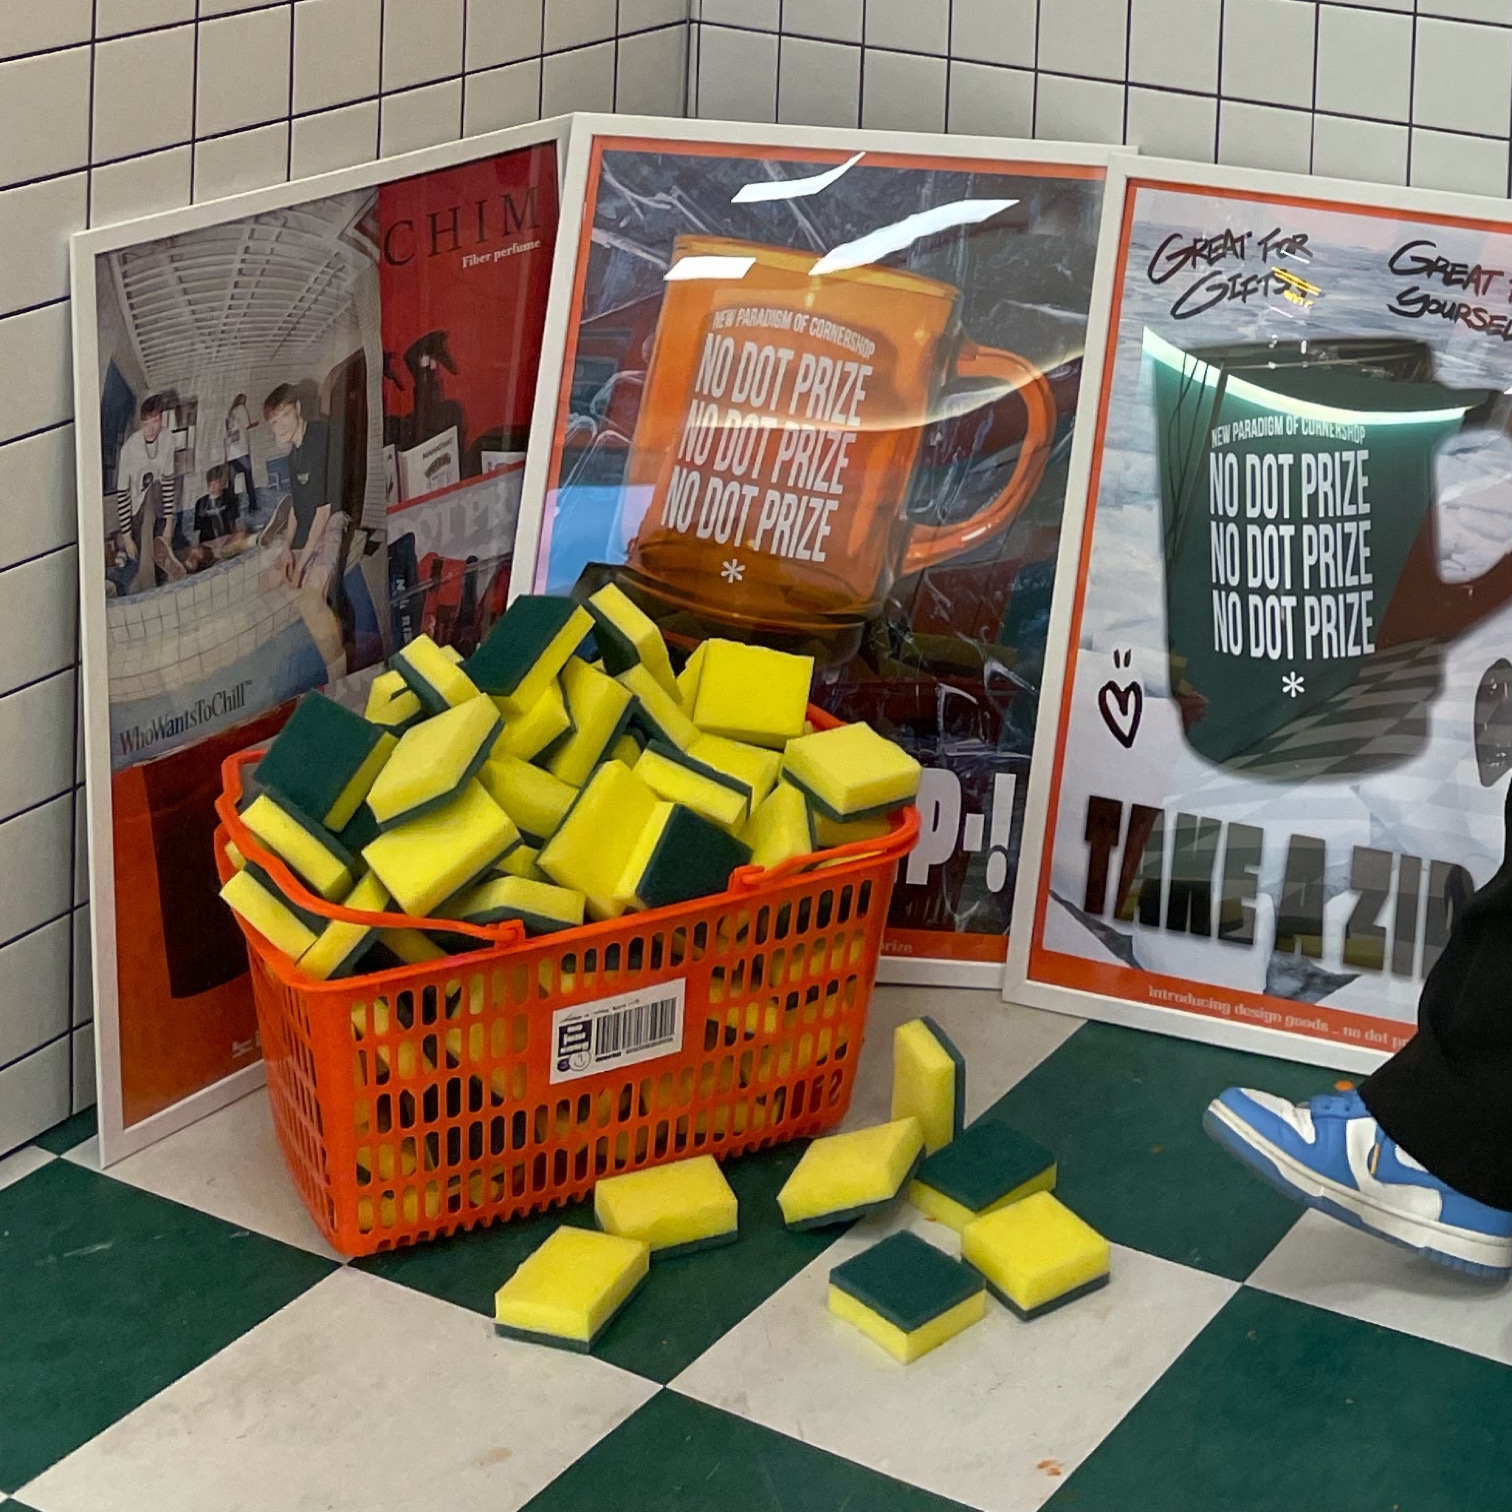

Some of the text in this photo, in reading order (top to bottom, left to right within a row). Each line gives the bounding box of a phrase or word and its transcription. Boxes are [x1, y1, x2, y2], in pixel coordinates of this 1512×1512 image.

[383, 187, 541, 267] CHIM
[1147, 227, 1313, 284] GREAT FOR
[1388, 240, 1504, 297] GREAT
[793, 313, 810, 333] OF
[809, 317, 876, 359] CORNERSHOP
[695, 333, 874, 426] NO DOT PRIZE
[678, 399, 857, 494] NO DOT PRIZE
[1211, 424, 1231, 448] NEW
[1232, 415, 1284, 441] PARADIGM
[1286, 414, 1299, 436] OF
[661, 465, 839, 562] NO DOT PRIZE
[1209, 449, 1371, 519] NO DOT PRIZE
[1210, 519, 1374, 590] NO DOT PRIZE
[1212, 589, 1376, 660] NO DOT PRIZE
[1084, 795, 1265, 946] TAKE
[1234, 1003, 1282, 1023] design
[1285, 1015, 1329, 1032] goods
[1365, 1029, 1388, 1044] dot
